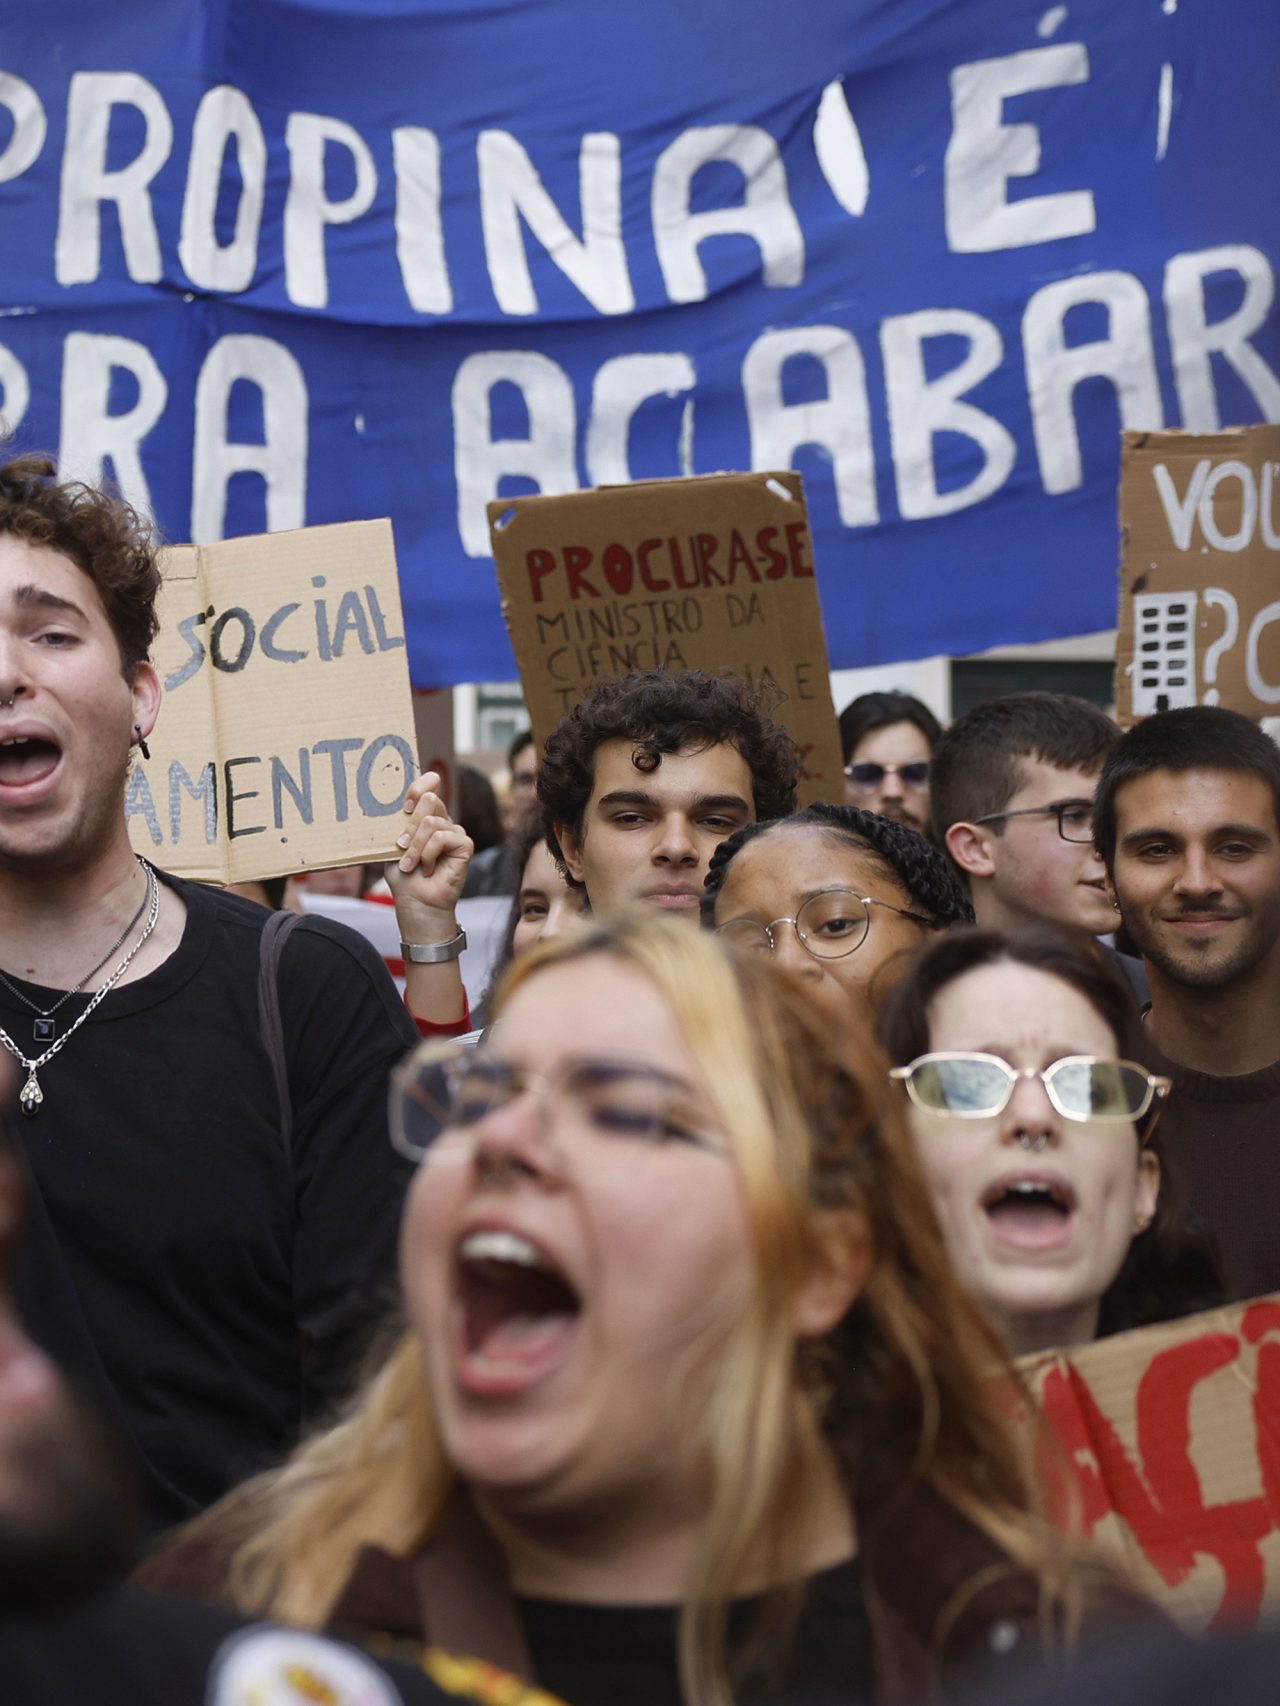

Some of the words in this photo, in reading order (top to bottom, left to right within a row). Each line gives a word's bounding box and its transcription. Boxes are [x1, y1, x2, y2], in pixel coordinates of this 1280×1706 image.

[944, 5, 1095, 253] É
[452, 244, 1280, 558] ACABAR
[536, 599, 703, 644] MINISTRO
[726, 592, 765, 629] DA
